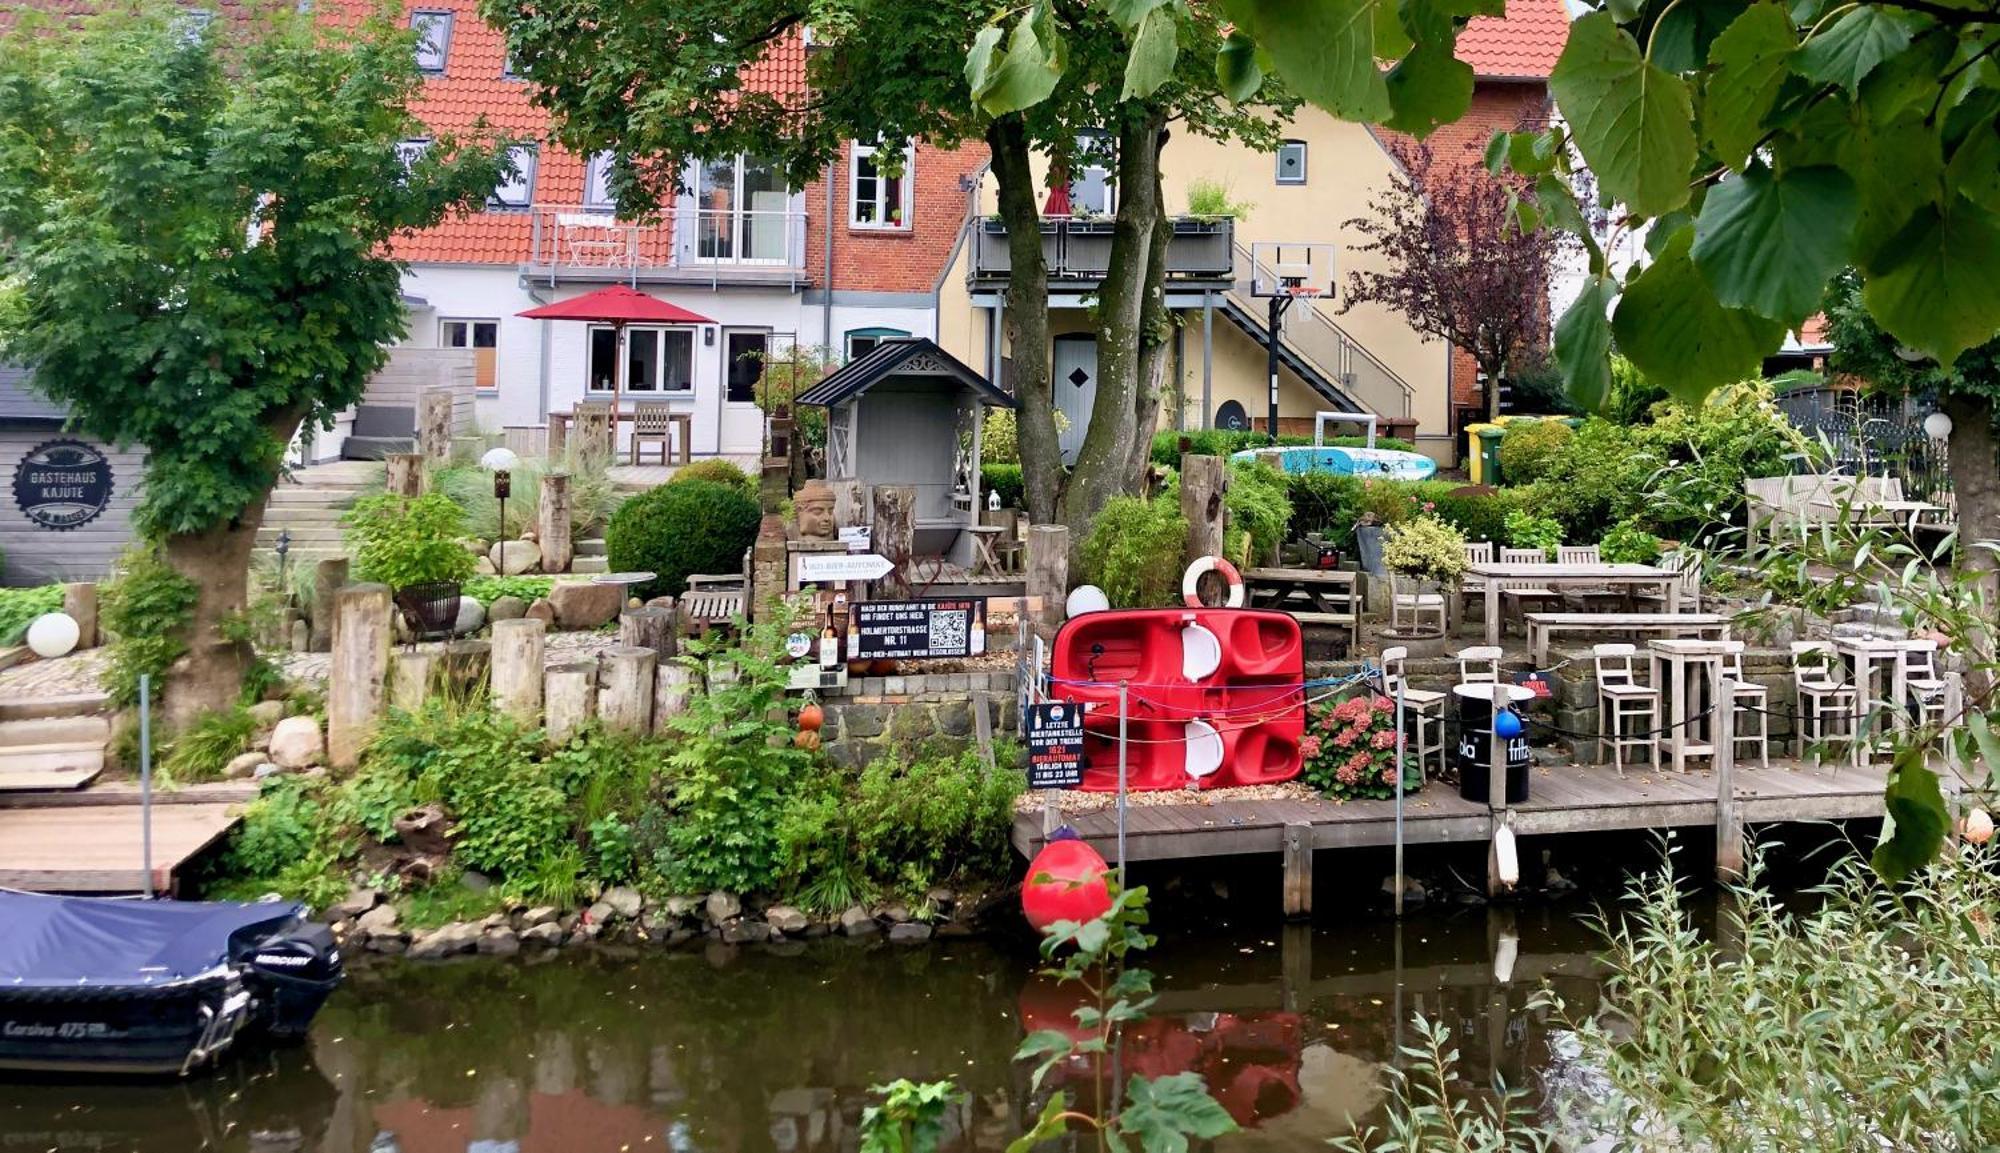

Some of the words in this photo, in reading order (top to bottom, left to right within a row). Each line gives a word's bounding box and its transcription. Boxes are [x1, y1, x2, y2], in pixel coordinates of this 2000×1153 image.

[872, 612, 894, 621] FINDET
[895, 612, 908, 620] UNS
[900, 635, 907, 645] 11
[1045, 721, 1069, 729] LETZTE
[1045, 738, 1058, 746] DER
[1048, 745, 1066, 754] 1621
[1031, 753, 1081, 763] BIERAUTOMAT
[1042, 771, 1053, 779] BIS
[1065, 770, 1078, 778] UHR
[255, 954, 314, 967] MERCURY
